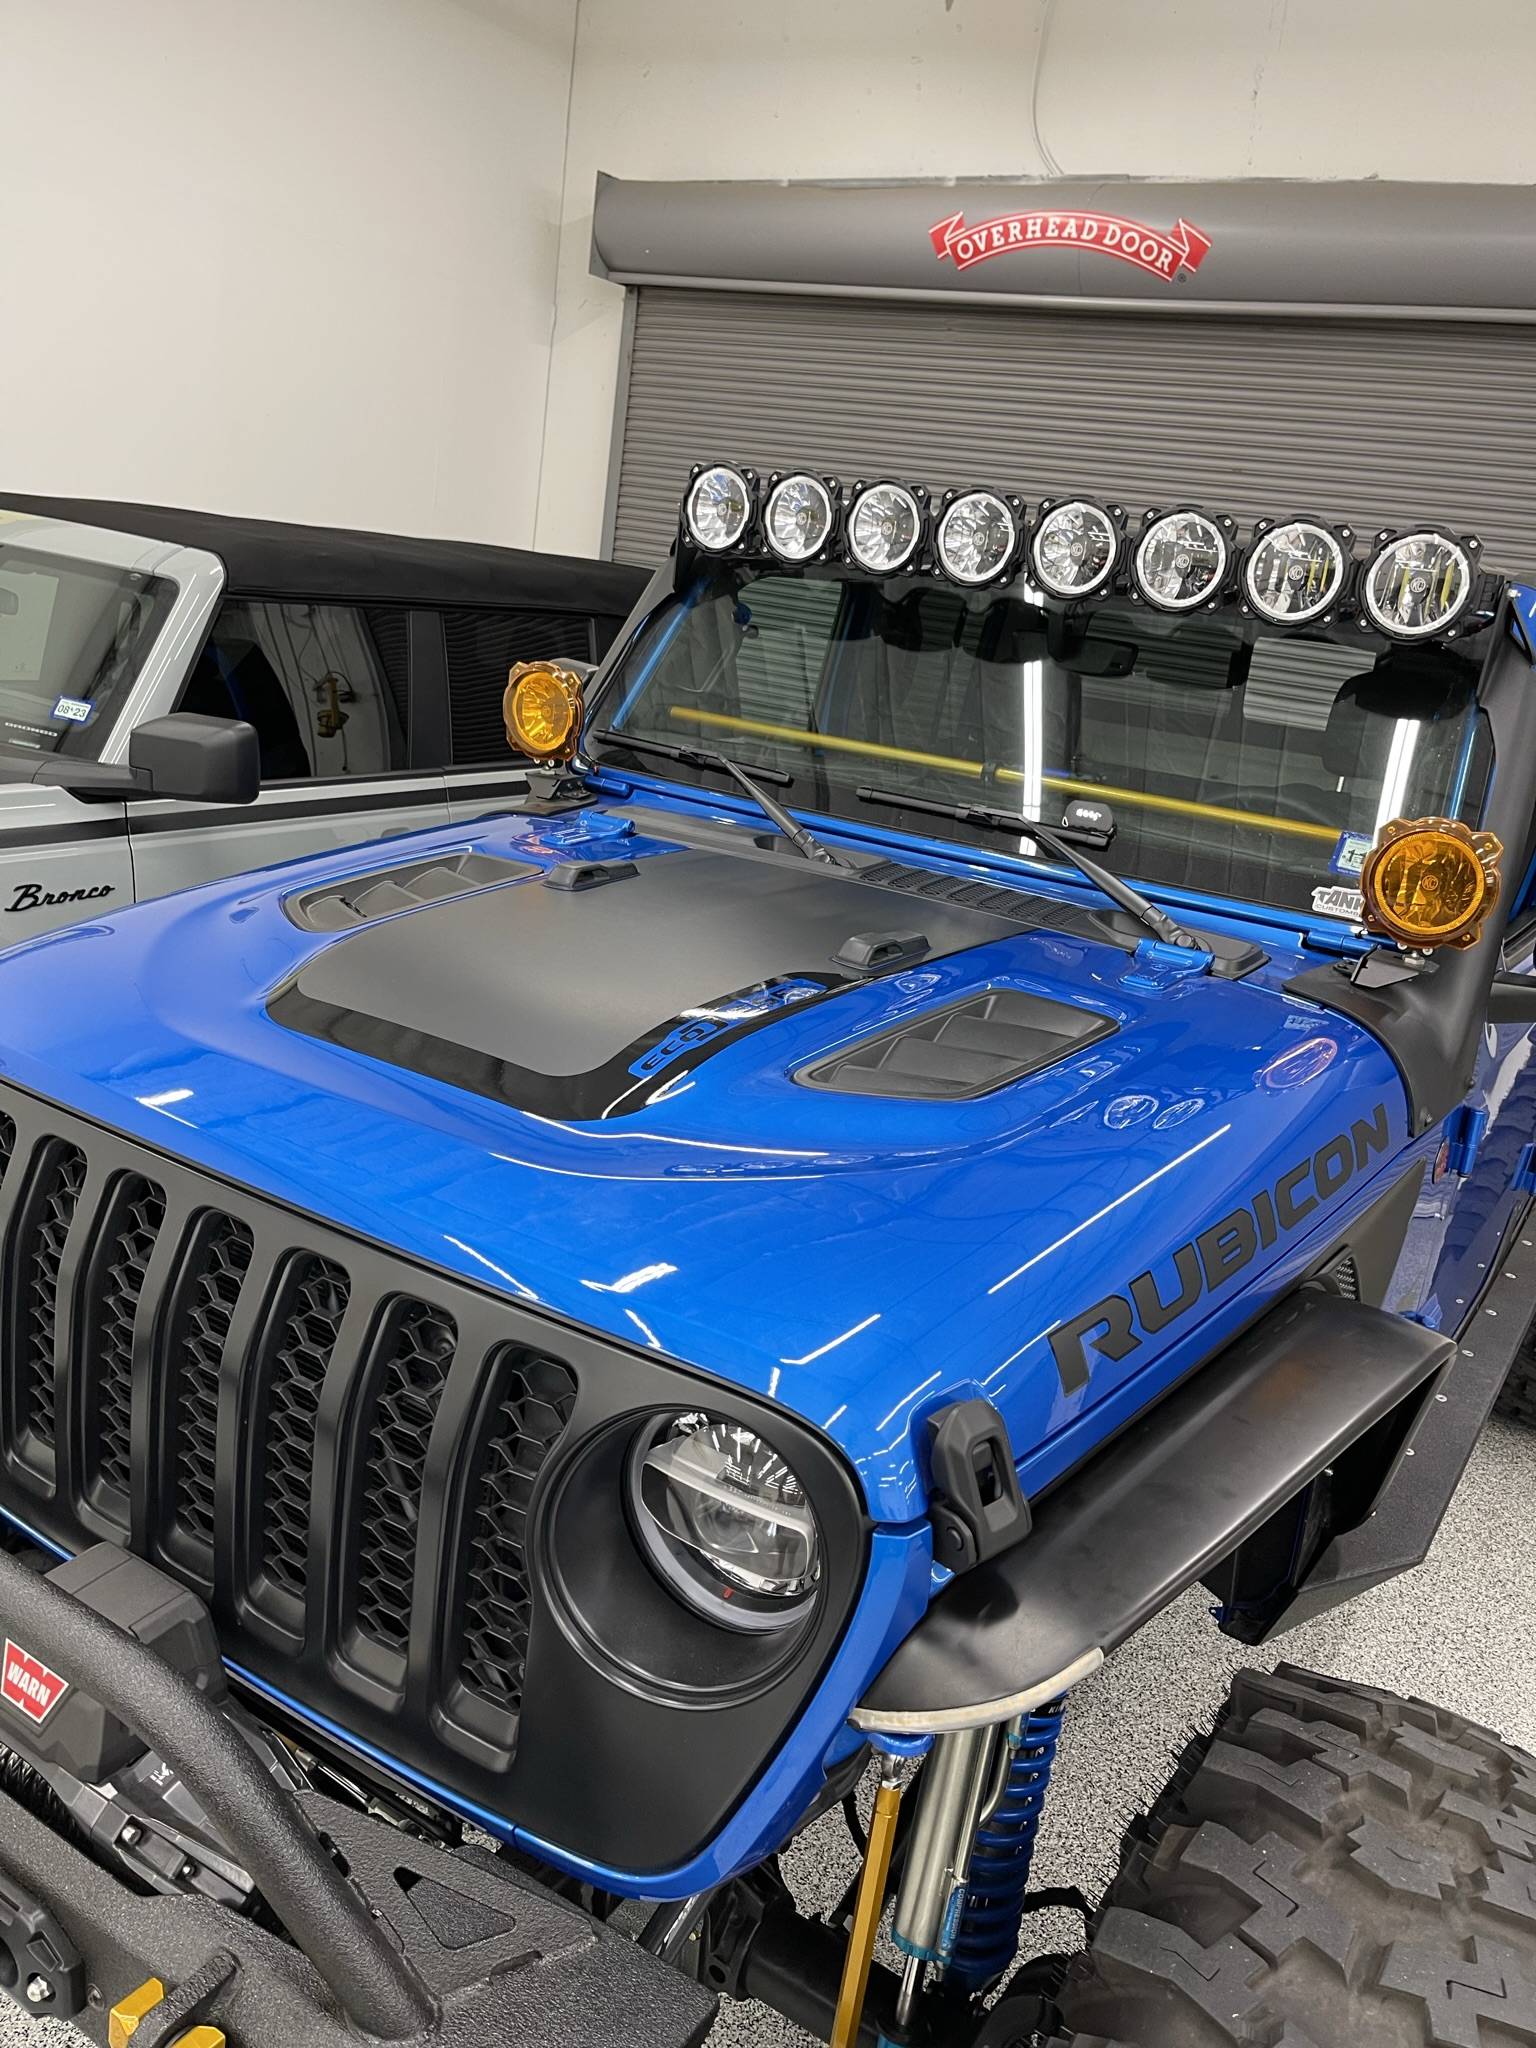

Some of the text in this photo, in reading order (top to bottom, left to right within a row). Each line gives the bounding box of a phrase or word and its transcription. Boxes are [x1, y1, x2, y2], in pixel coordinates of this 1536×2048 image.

[957, 216, 1173, 273] OVERHEAD DOOR
[4, 884, 115, 912] Bronco
[1423, 876, 1438, 889] KC
[1047, 1104, 1389, 1397] RUBICON
[7, 1661, 51, 1707] WARN
